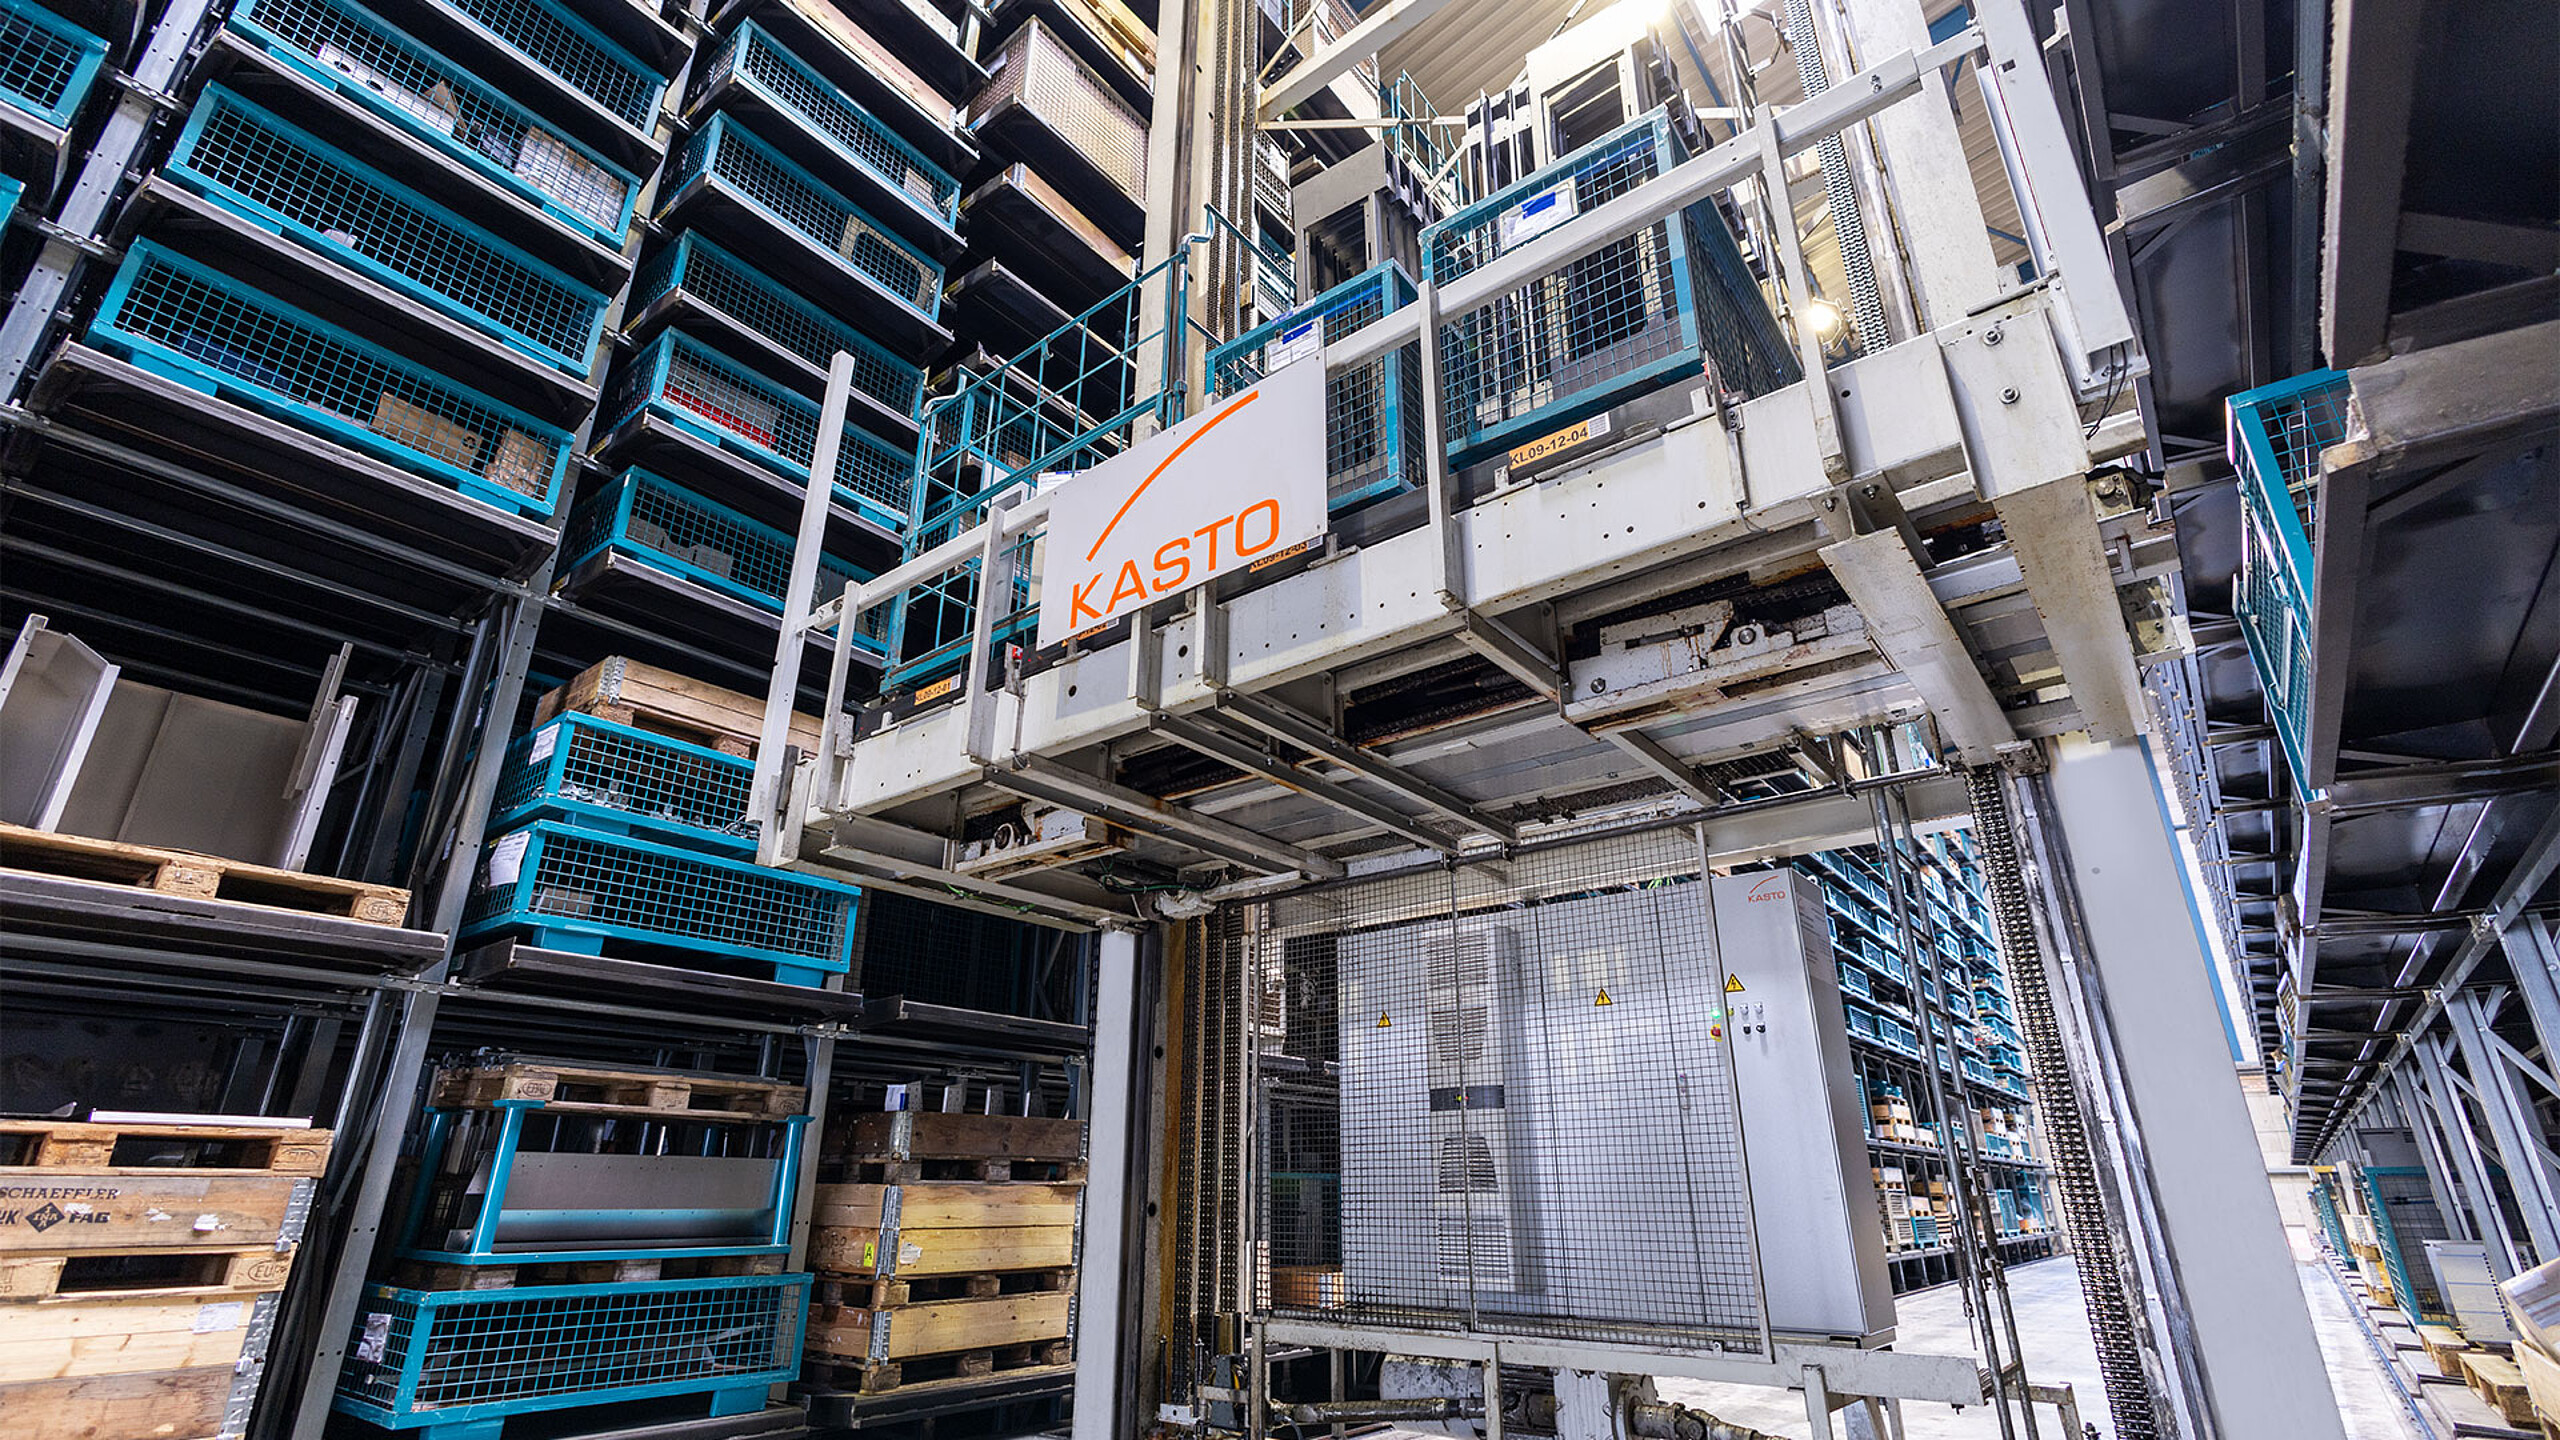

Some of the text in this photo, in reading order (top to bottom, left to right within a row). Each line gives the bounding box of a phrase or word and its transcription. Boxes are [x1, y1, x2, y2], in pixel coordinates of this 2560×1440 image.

[1511, 427, 1588, 466] KL09-12-04
[1069, 498, 1280, 629] KASTO
[1747, 890, 1786, 903] KASTO
